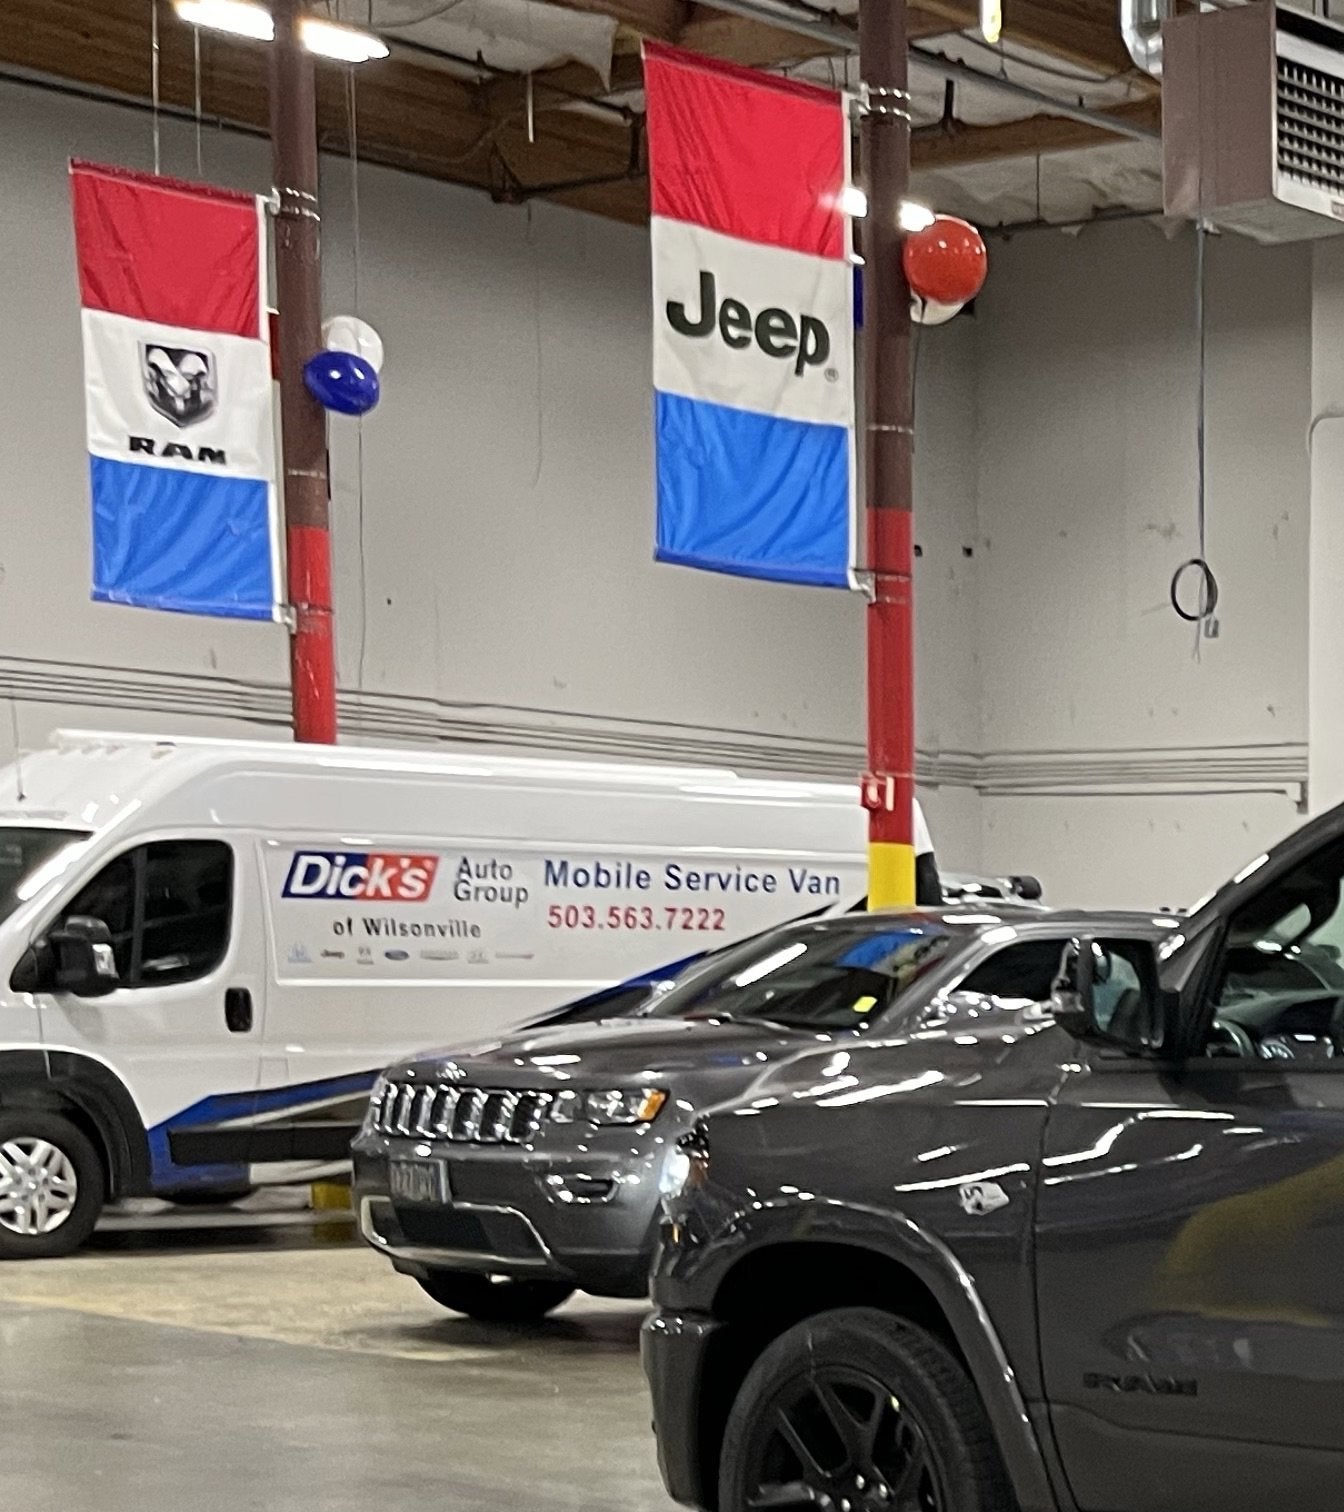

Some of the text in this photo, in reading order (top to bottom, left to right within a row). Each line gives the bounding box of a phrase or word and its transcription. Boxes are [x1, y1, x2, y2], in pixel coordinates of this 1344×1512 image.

[666, 269, 830, 377] Jeep
[128, 435, 226, 465] RAM
[456, 855, 513, 880] Auto
[545, 859, 840, 894] Mobile Service Van
[454, 879, 529, 910] Group
[333, 916, 481, 938] of Wilsonville
[547, 904, 726, 931] 503.563.7222
